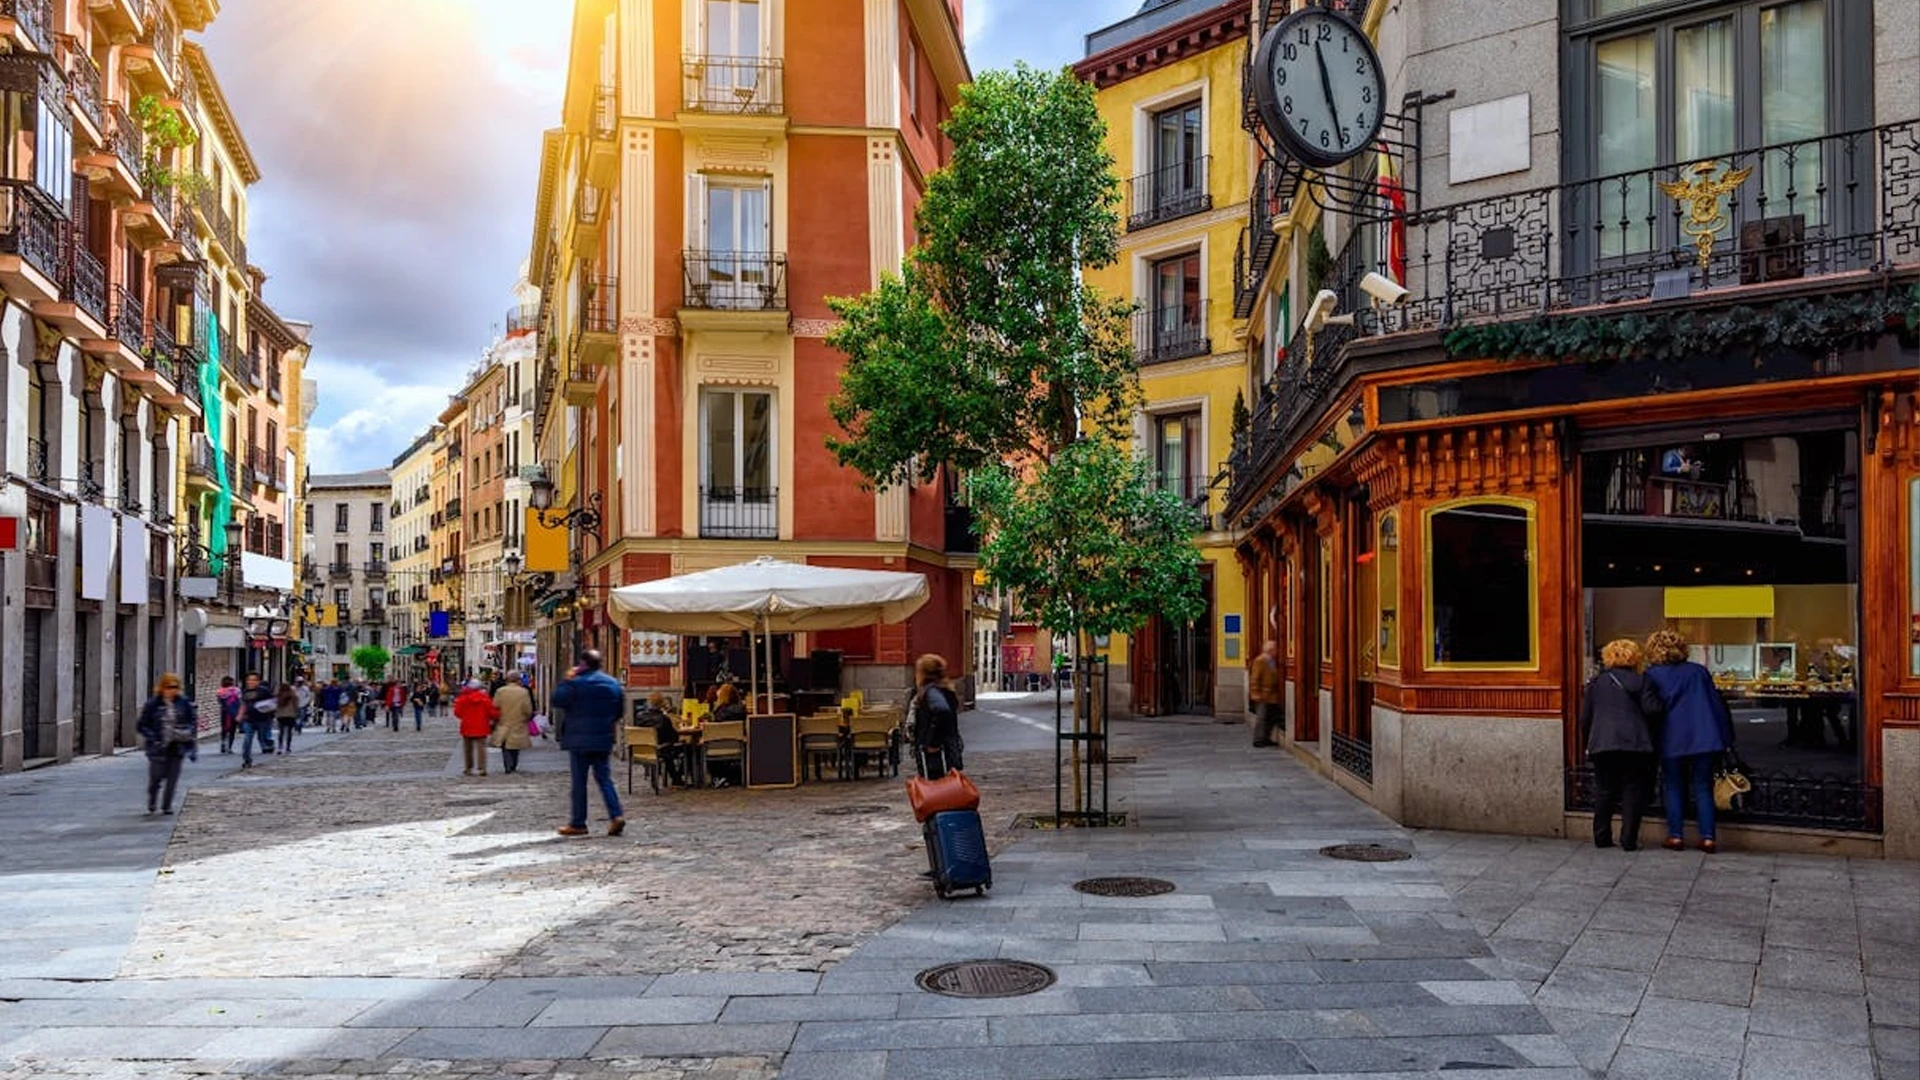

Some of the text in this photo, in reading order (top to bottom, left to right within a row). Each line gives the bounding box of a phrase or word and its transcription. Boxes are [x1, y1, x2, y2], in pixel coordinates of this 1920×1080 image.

[1299, 28, 1310, 46] 11
[1317, 24, 1331, 42] 12
[1282, 43, 1297, 61] 10
[1342, 36, 1348, 53] 1
[1356, 57, 1365, 75] 2
[1277, 67, 1287, 86] 9
[1362, 86, 1371, 103] 3
[1283, 96, 1293, 114] 8
[1300, 119, 1309, 136] 7
[1356, 112, 1364, 129] 4
[1320, 130, 1330, 147] 6
[1341, 127, 1350, 144] 5
